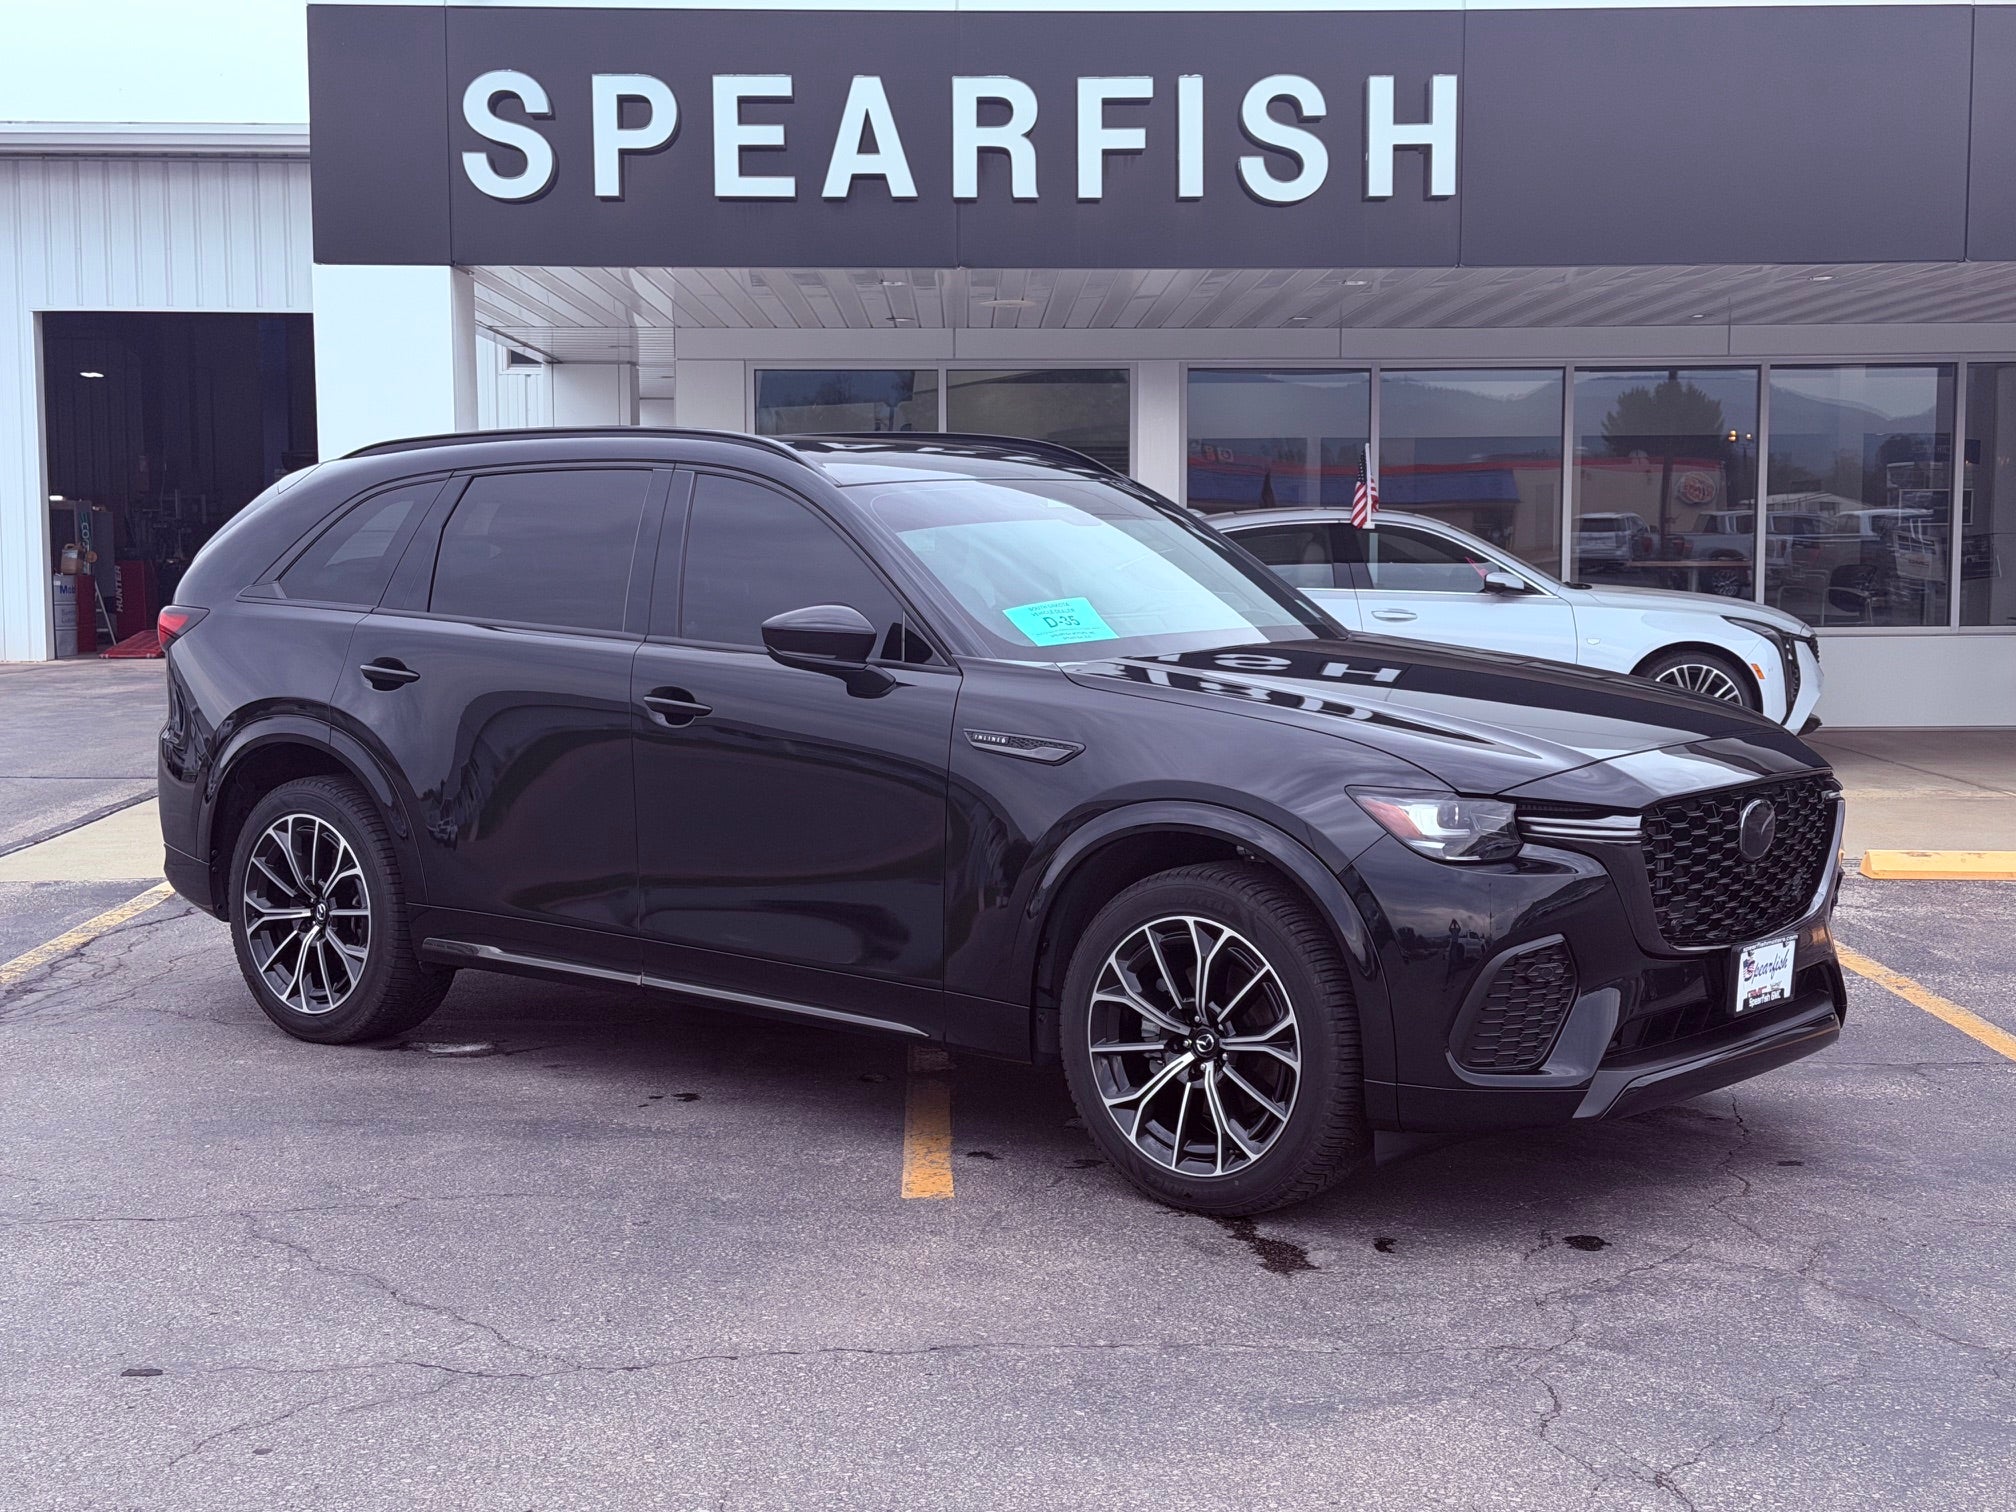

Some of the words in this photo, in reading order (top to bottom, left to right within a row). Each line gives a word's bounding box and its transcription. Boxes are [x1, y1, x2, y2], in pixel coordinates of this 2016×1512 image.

[460, 69, 1460, 203] SPEARFISH
[114, 565, 124, 613] HUNTER
[1042, 614, 1081, 629] D-35
[1743, 948, 1790, 984] Spearfish
